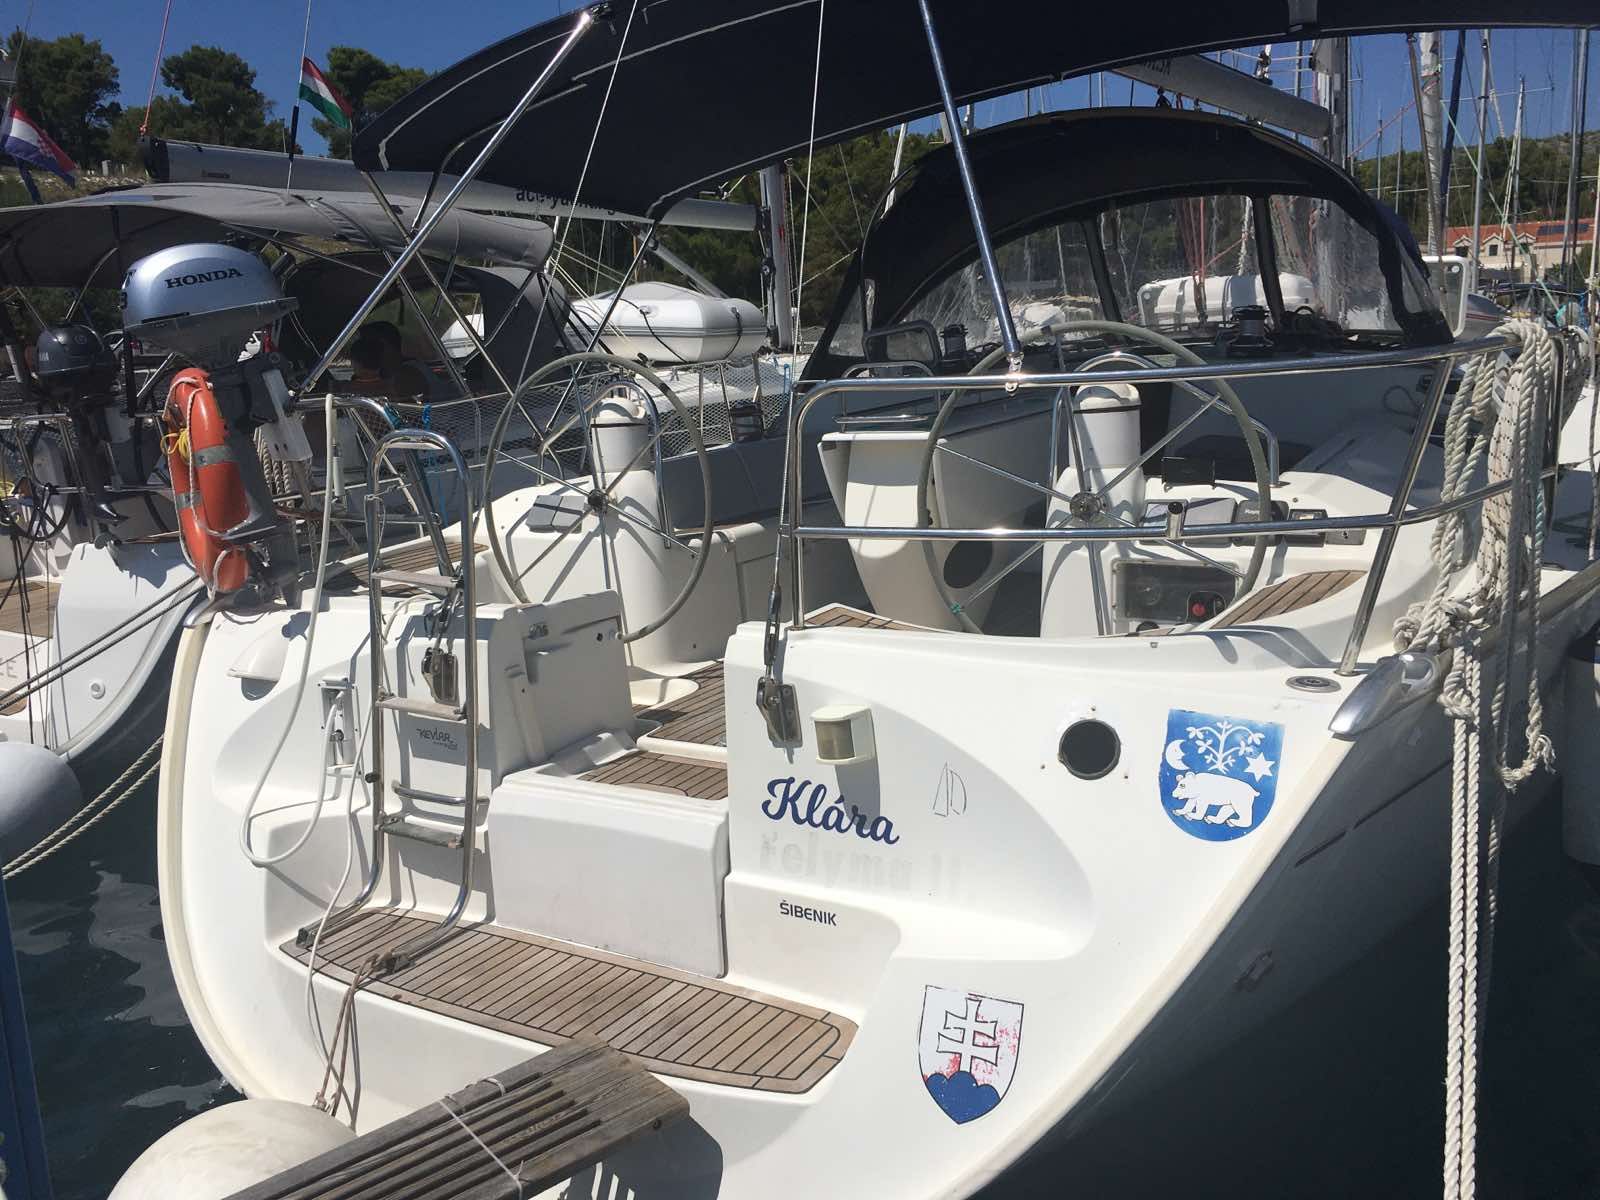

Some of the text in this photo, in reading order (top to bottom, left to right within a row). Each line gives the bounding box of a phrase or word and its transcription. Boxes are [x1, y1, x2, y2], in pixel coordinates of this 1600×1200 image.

[164, 267, 244, 289] HONDA
[761, 776, 900, 845] Klára
[779, 899, 838, 927] ŠIBENIK
